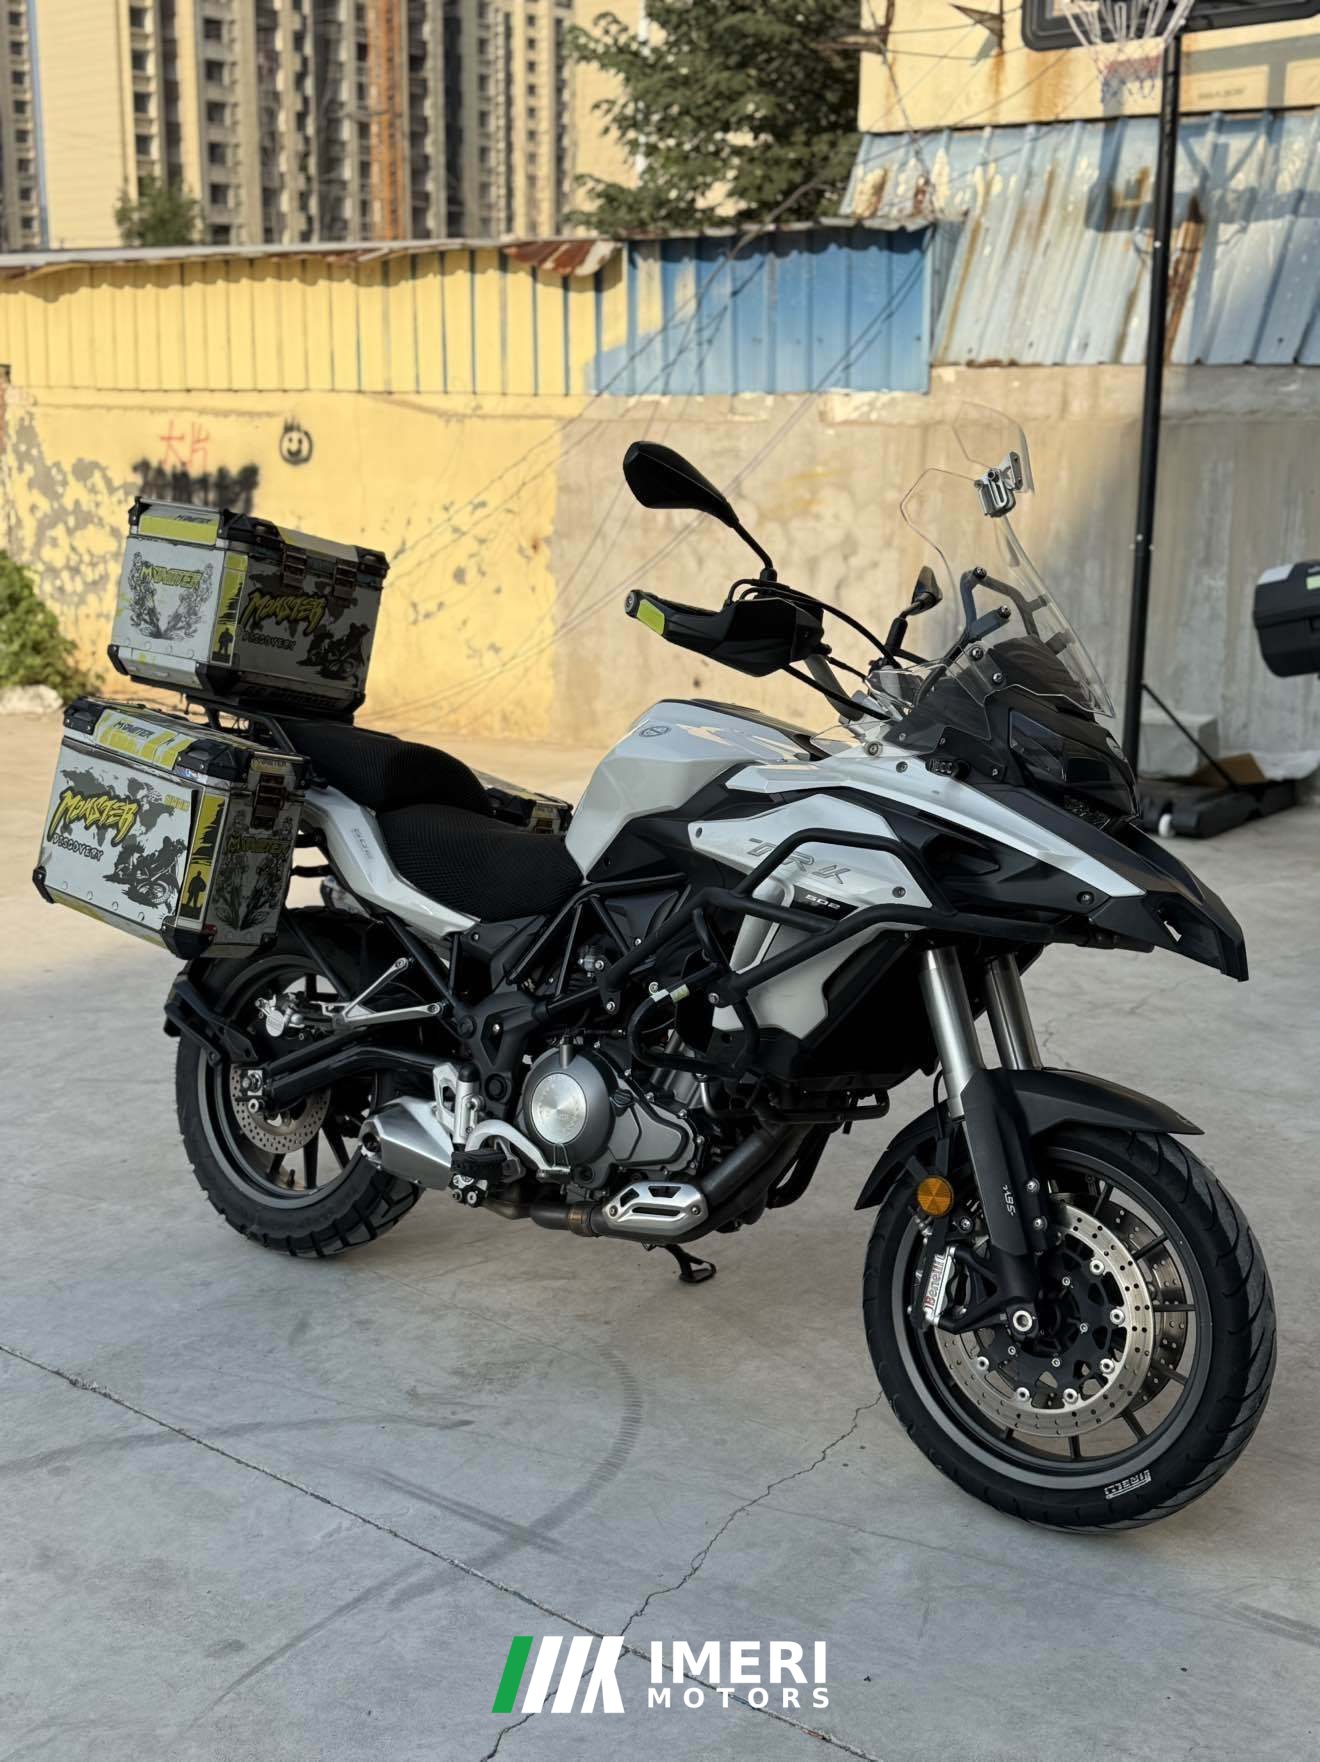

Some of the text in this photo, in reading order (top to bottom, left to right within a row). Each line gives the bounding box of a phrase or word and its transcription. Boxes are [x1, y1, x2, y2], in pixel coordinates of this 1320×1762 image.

[239, 587, 328, 637] MONSTER
[47, 786, 141, 847] MONSTER
[52, 832, 104, 861] DISCOVERY
[747, 837, 852, 885] TRK
